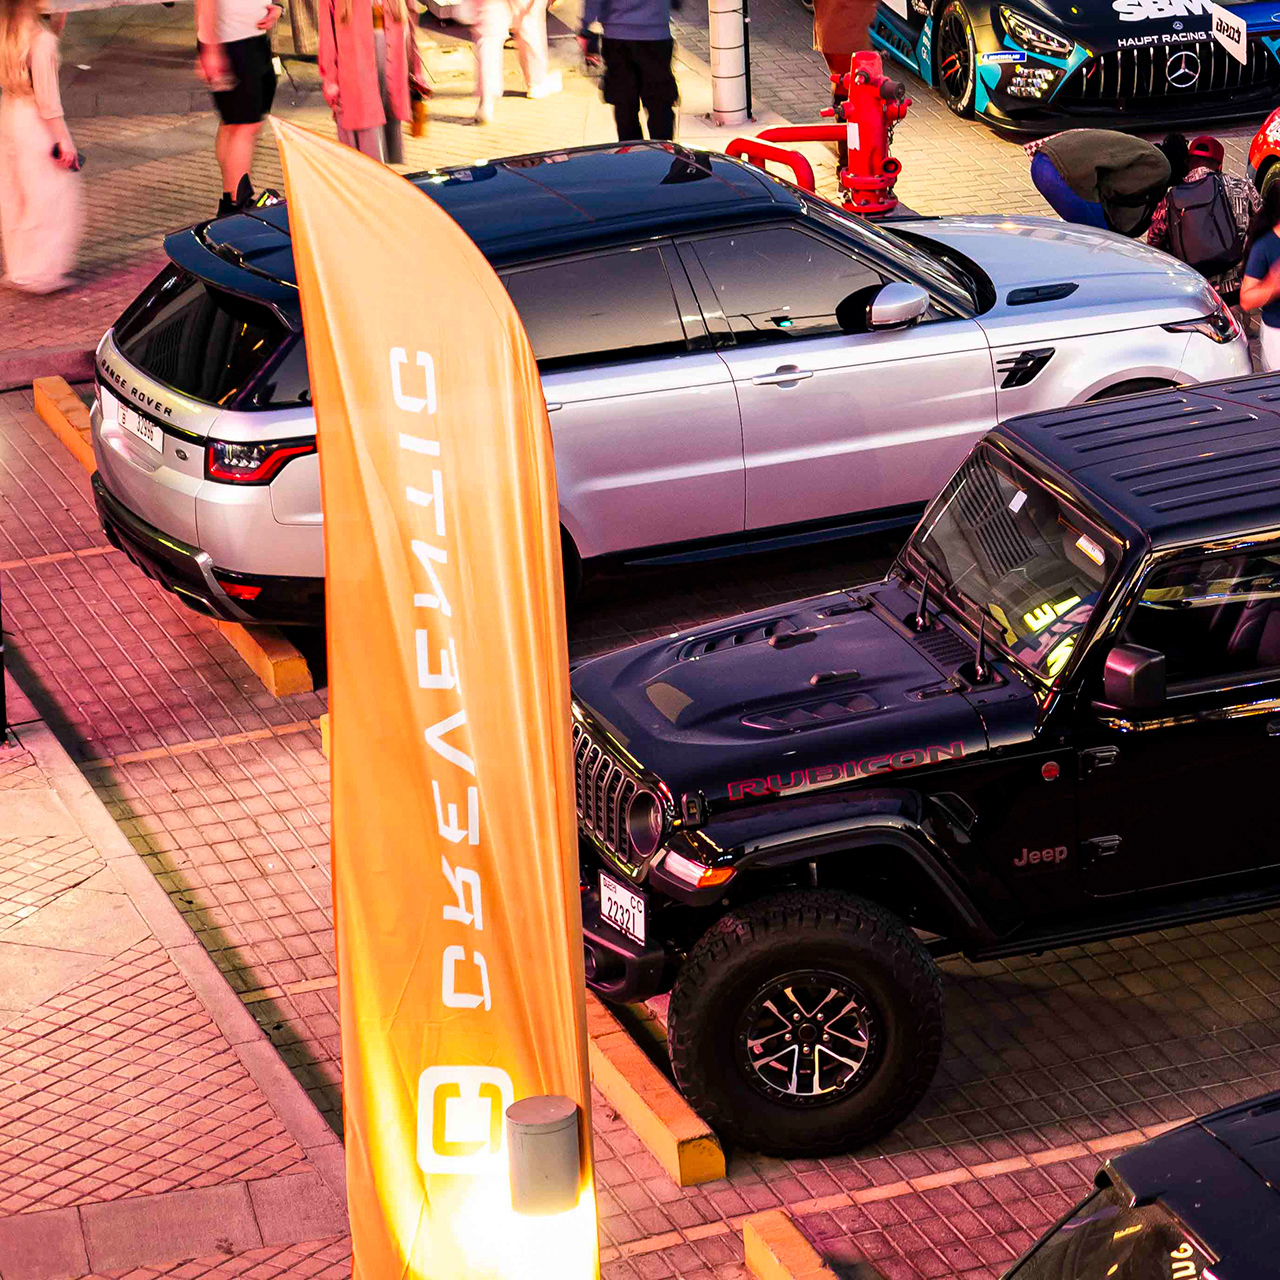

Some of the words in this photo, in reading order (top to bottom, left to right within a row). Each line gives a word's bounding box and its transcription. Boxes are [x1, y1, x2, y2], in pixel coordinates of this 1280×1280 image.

[1117, 35, 1159, 48] HAUPT
[1161, 32, 1207, 45] RACING
[100, 359, 128, 391] RANGE
[129, 390, 173, 418] ROVER
[727, 740, 967, 802] RUBICON
[1013, 842, 1069, 869] Jeep
[607, 895, 639, 934] 22321
